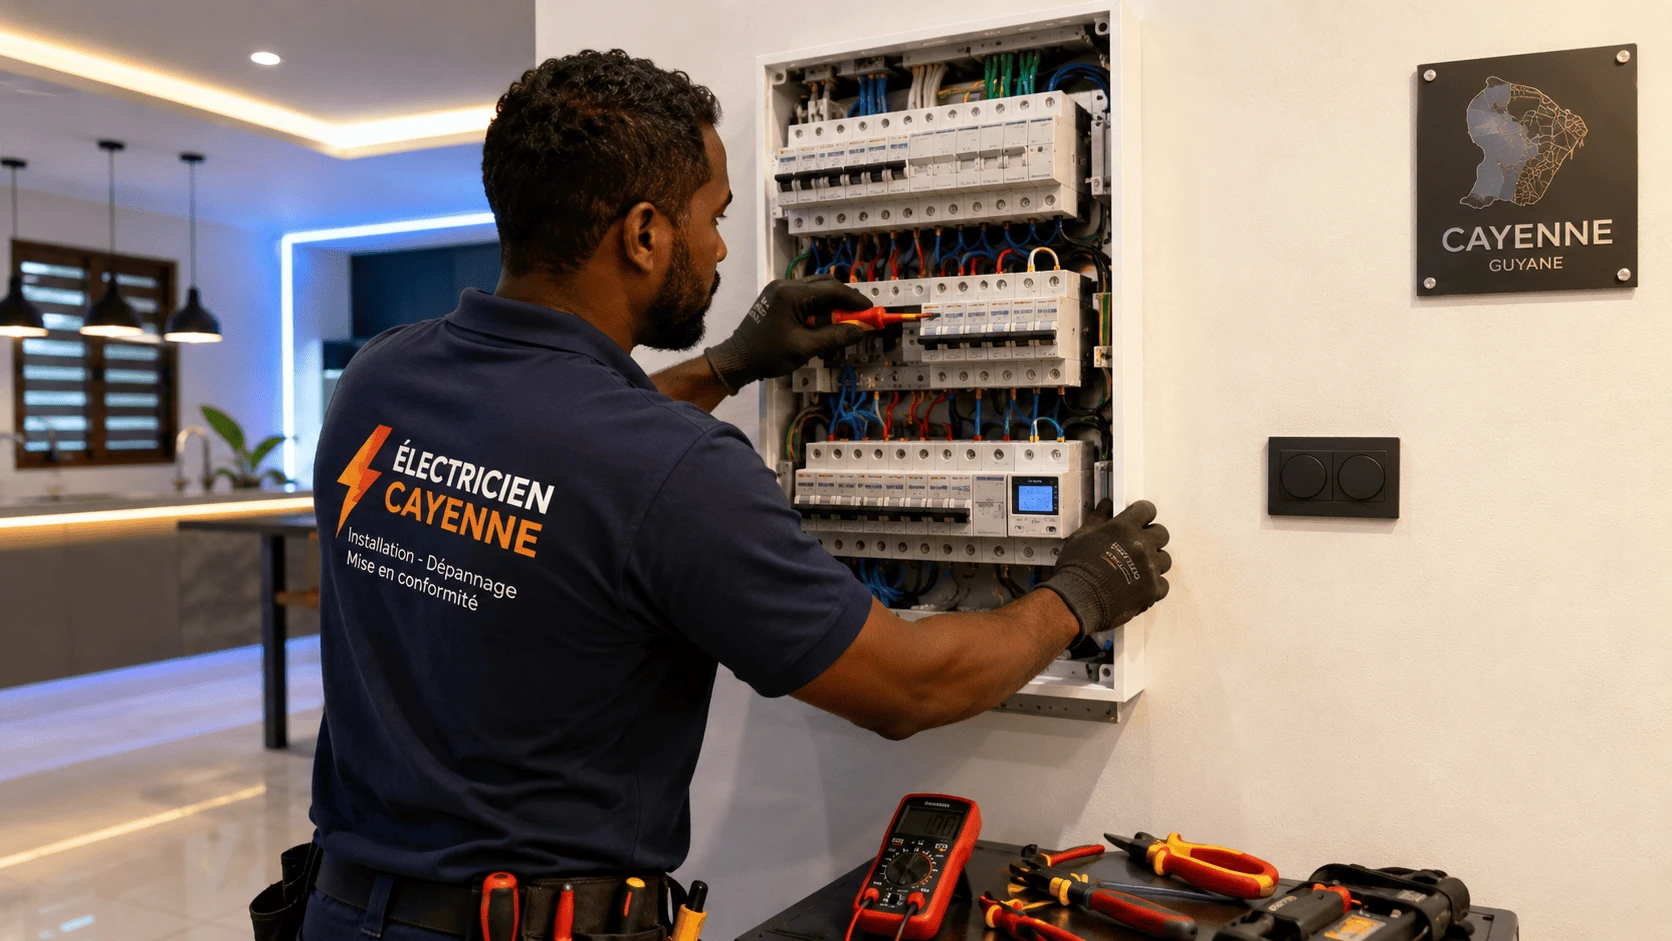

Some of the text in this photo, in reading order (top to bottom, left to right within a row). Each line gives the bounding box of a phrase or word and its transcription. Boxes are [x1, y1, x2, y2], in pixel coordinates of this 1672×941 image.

[1442, 218, 1613, 252] CAYENNE
[1489, 256, 1564, 272] GUYANE
[392, 439, 555, 515] ÉLECTRICIEN
[384, 481, 543, 559] CAYENNE
[346, 550, 478, 611] Mise en conformité
[348, 526, 415, 564] Installation
[426, 554, 517, 599] Dépannage
